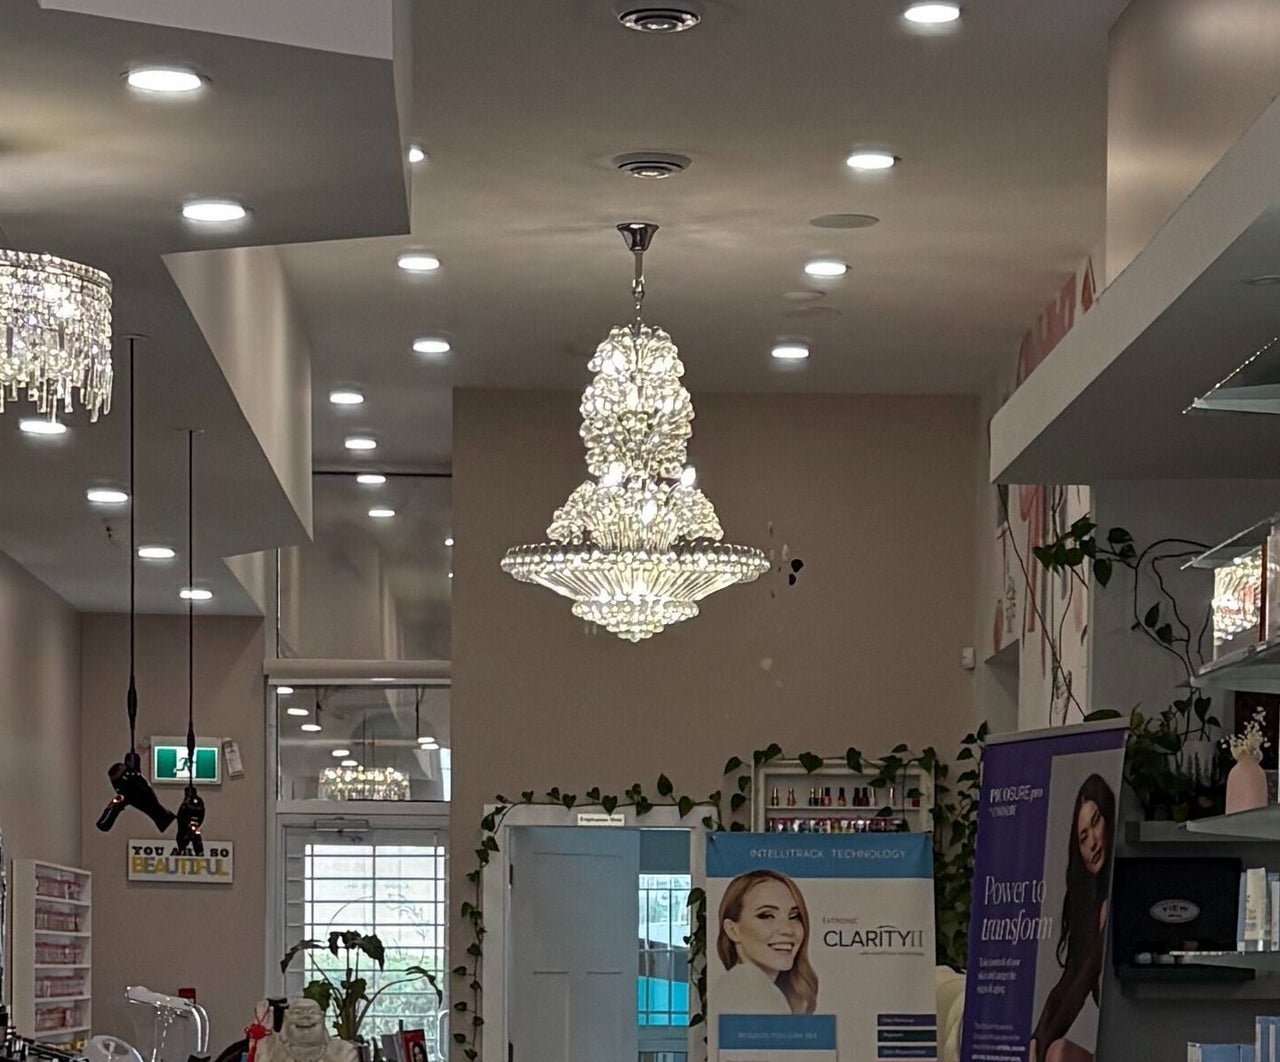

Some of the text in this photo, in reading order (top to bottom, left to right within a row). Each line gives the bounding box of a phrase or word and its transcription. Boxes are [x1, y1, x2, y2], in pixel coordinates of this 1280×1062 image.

[132, 846, 165, 857] YOU
[210, 848, 230, 858] SO
[750, 849, 906, 859] INTELLITRACK TECHNOLOGY
[132, 856, 230, 876] BEAUTIFUL
[985, 876, 1047, 905] Power to
[981, 909, 1053, 945] transform
